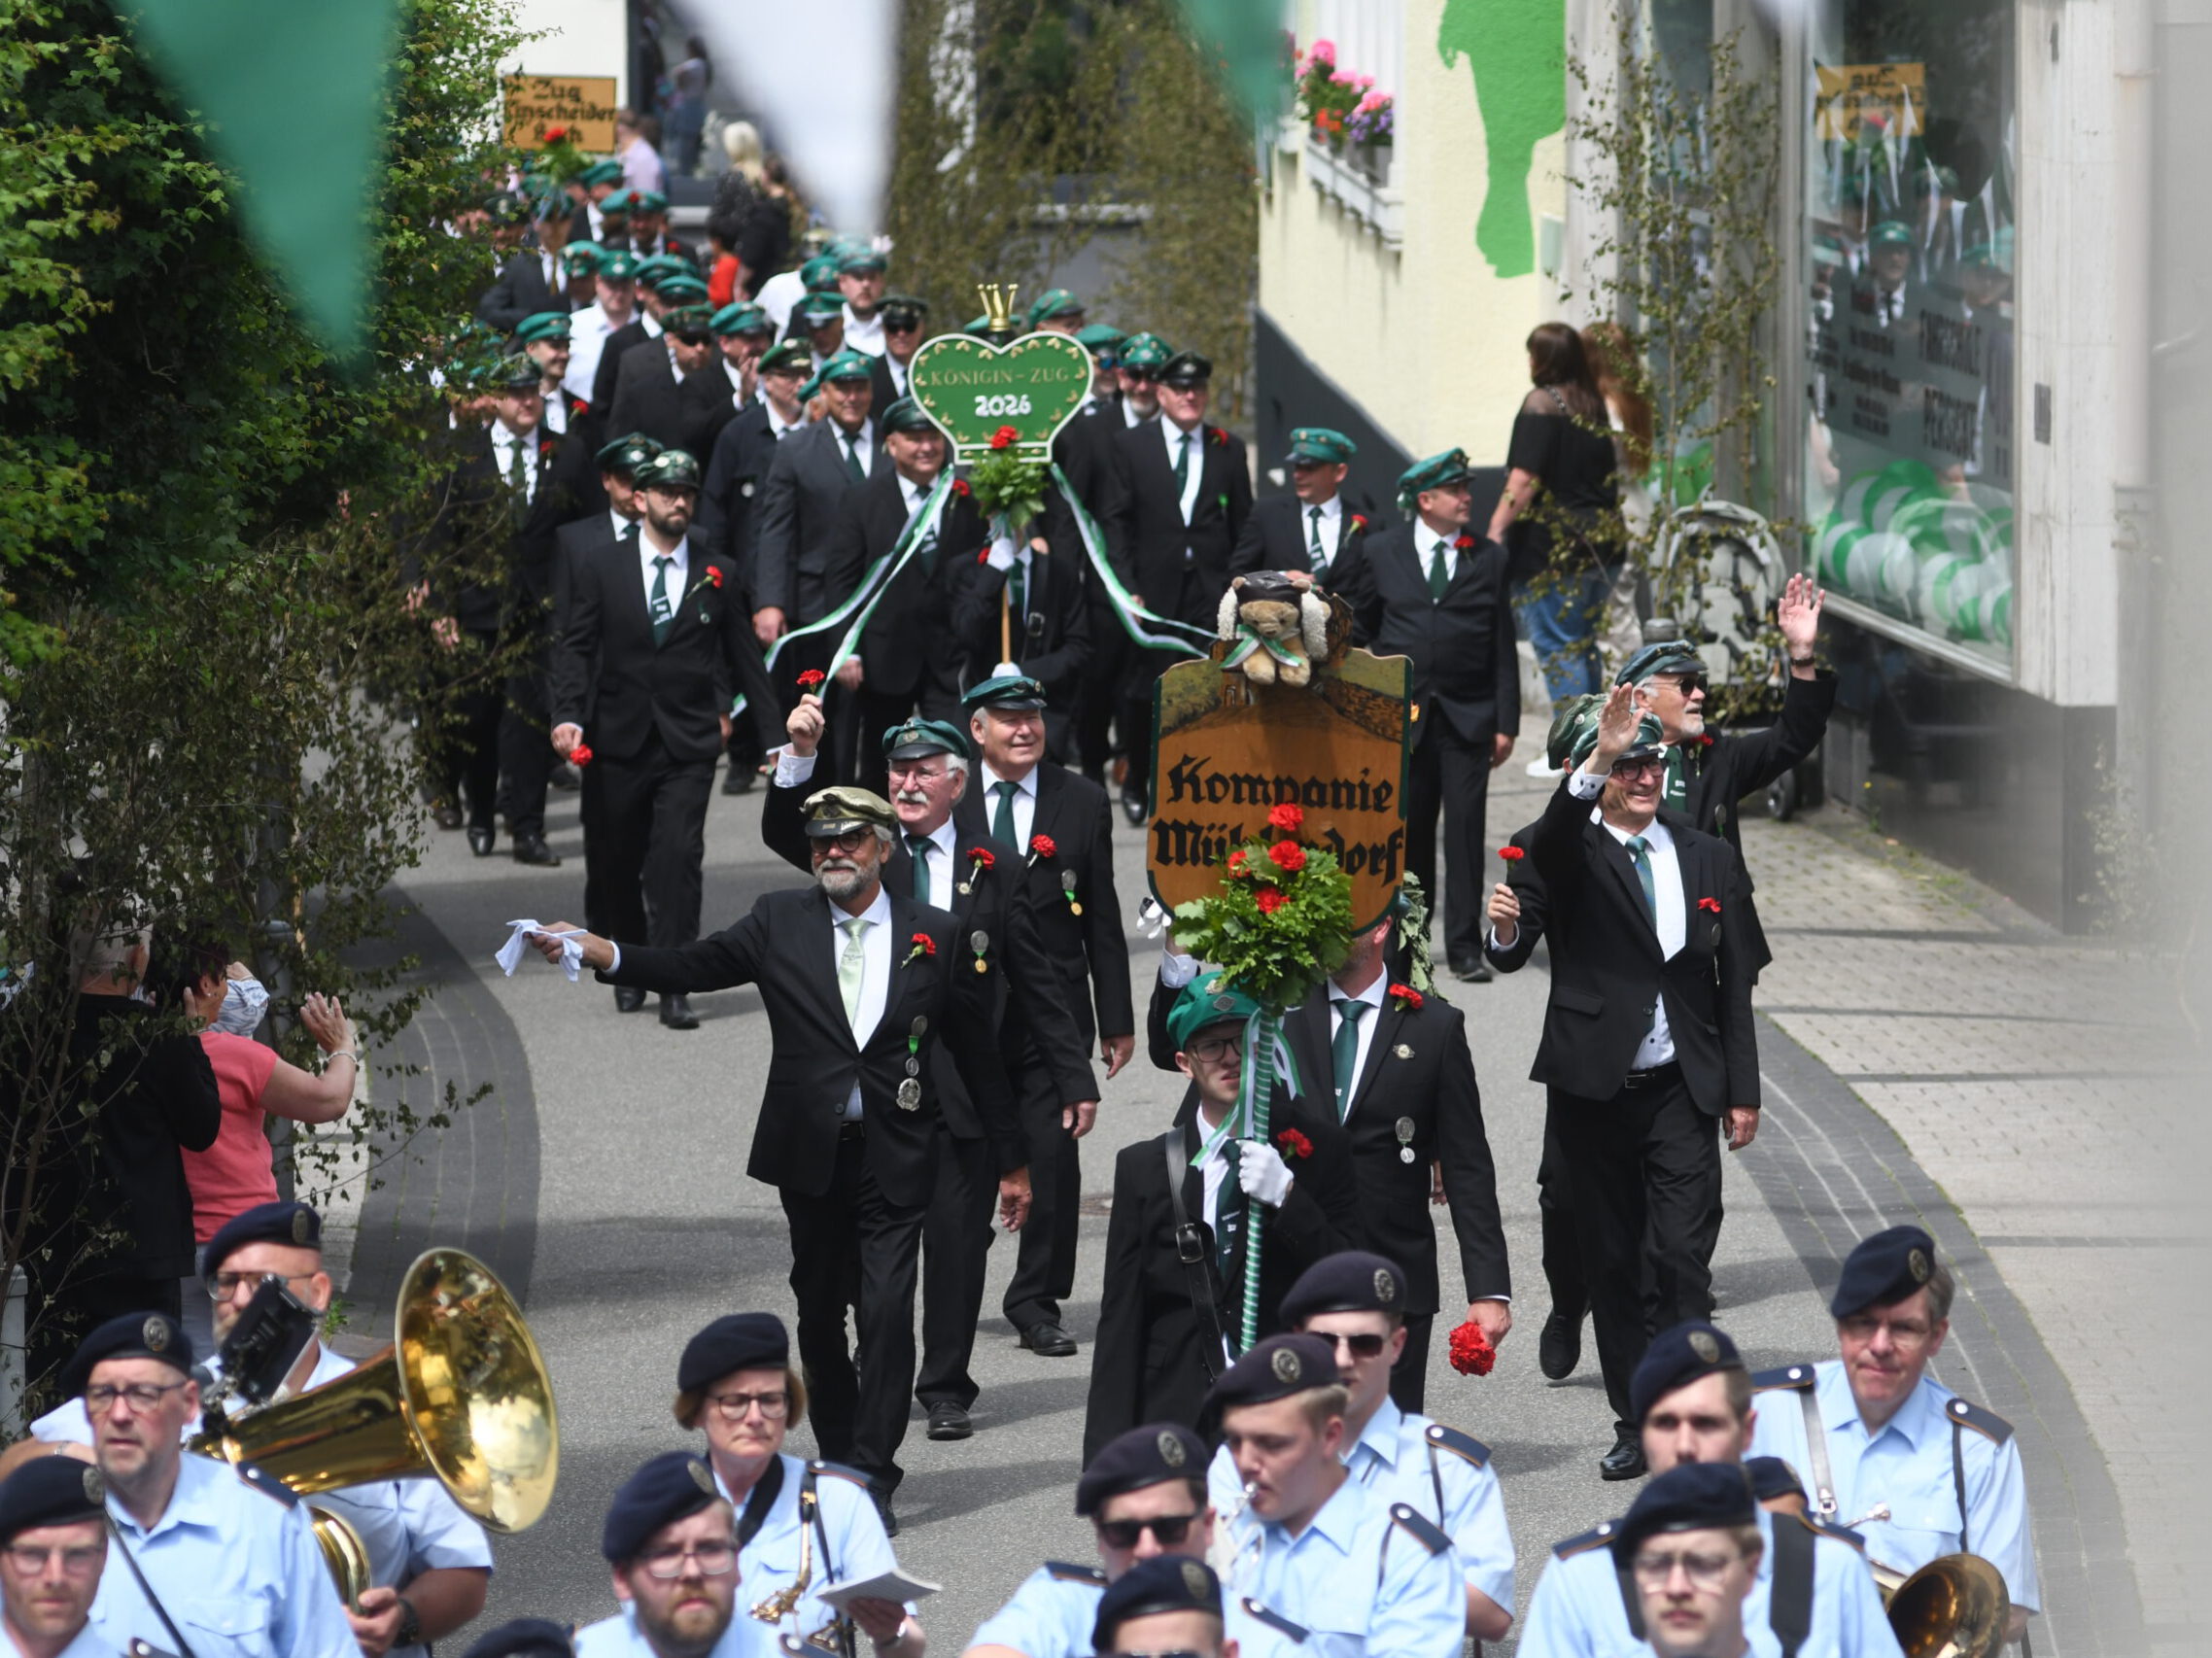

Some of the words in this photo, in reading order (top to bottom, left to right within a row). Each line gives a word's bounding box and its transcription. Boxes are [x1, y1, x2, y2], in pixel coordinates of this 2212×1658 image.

[533, 79, 581, 103] Zug
[533, 123, 583, 143] Bh
[930, 366, 1014, 386] KÖNIGIN
[1029, 367, 1069, 384] ZUG
[974, 394, 1032, 418] 2026
[1166, 753, 1394, 813] Kompanie
[1152, 818, 1404, 886] Müdorf
